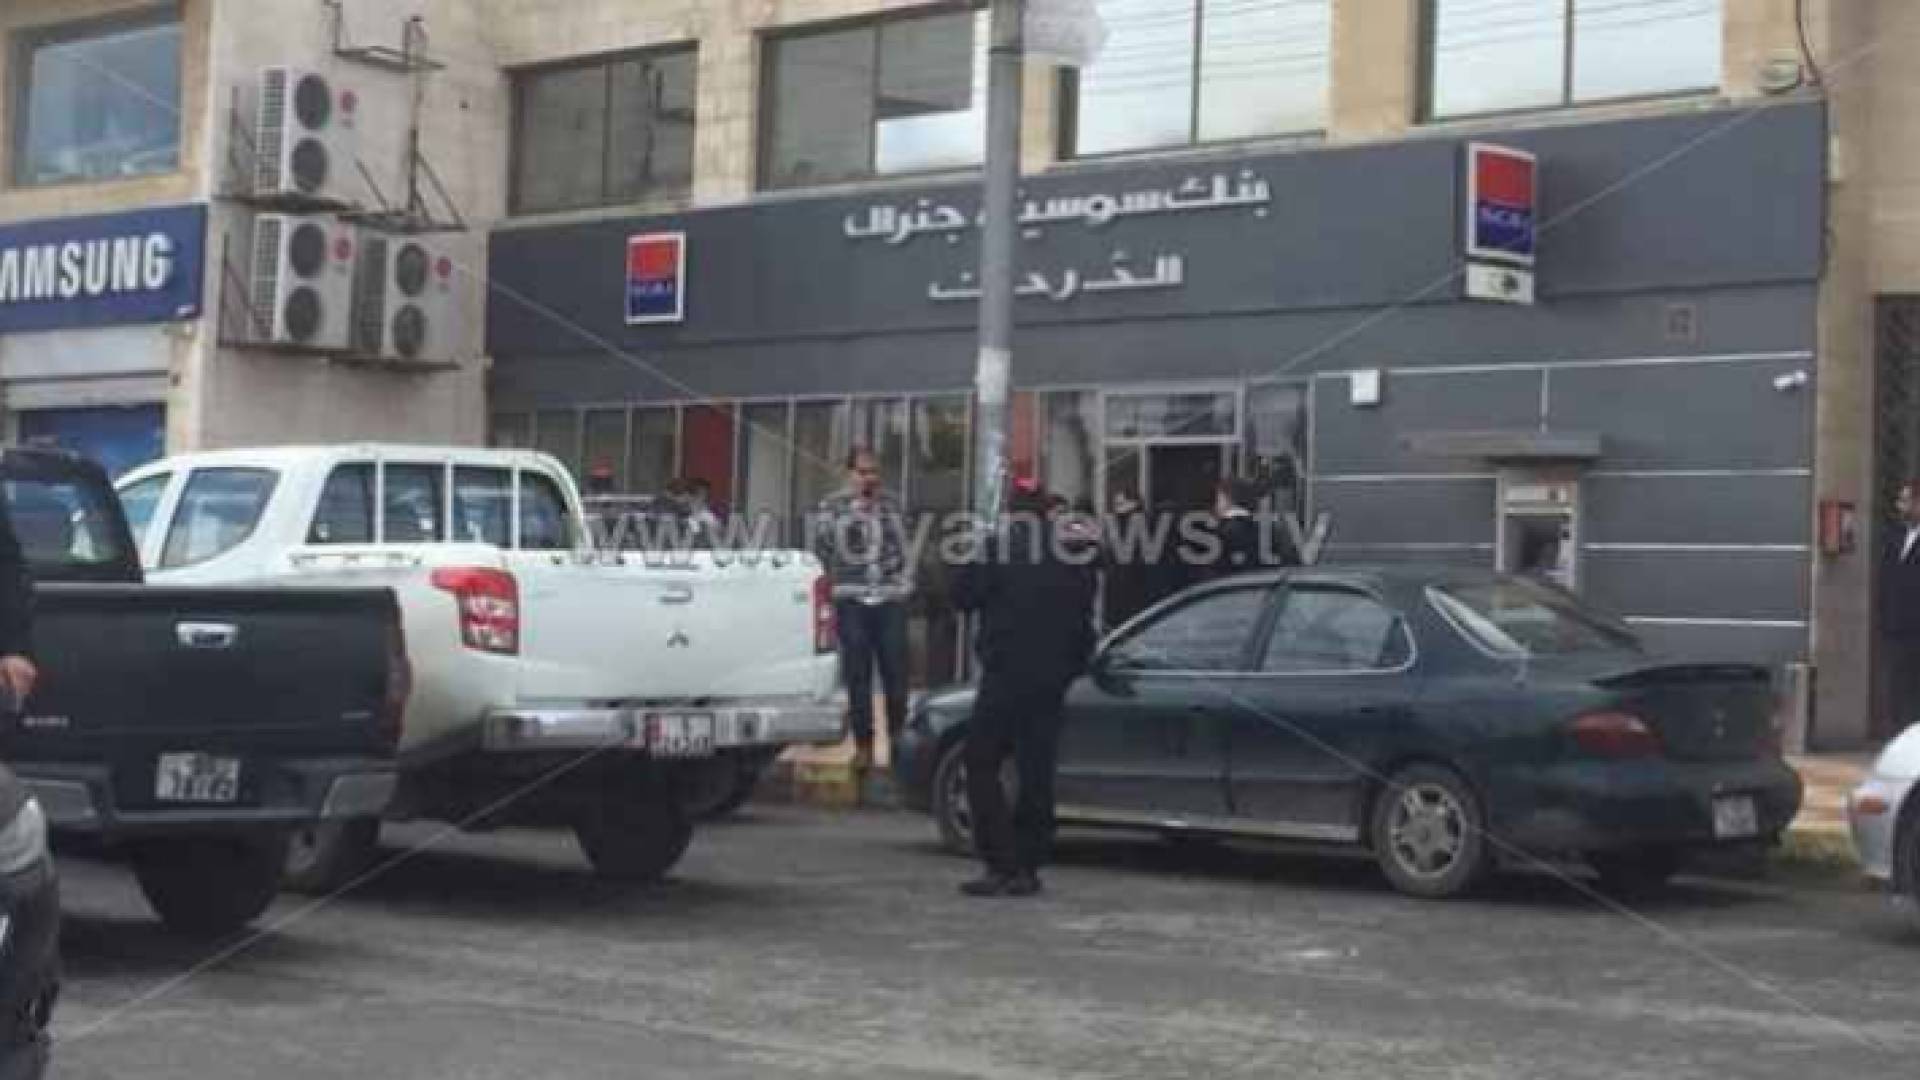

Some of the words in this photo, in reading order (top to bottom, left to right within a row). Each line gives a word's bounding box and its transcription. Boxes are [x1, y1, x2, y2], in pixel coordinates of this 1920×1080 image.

[975, 188, 1165, 240] سوسي
[1164, 167, 1271, 219] بنك
[844, 199, 966, 244] جنرال
